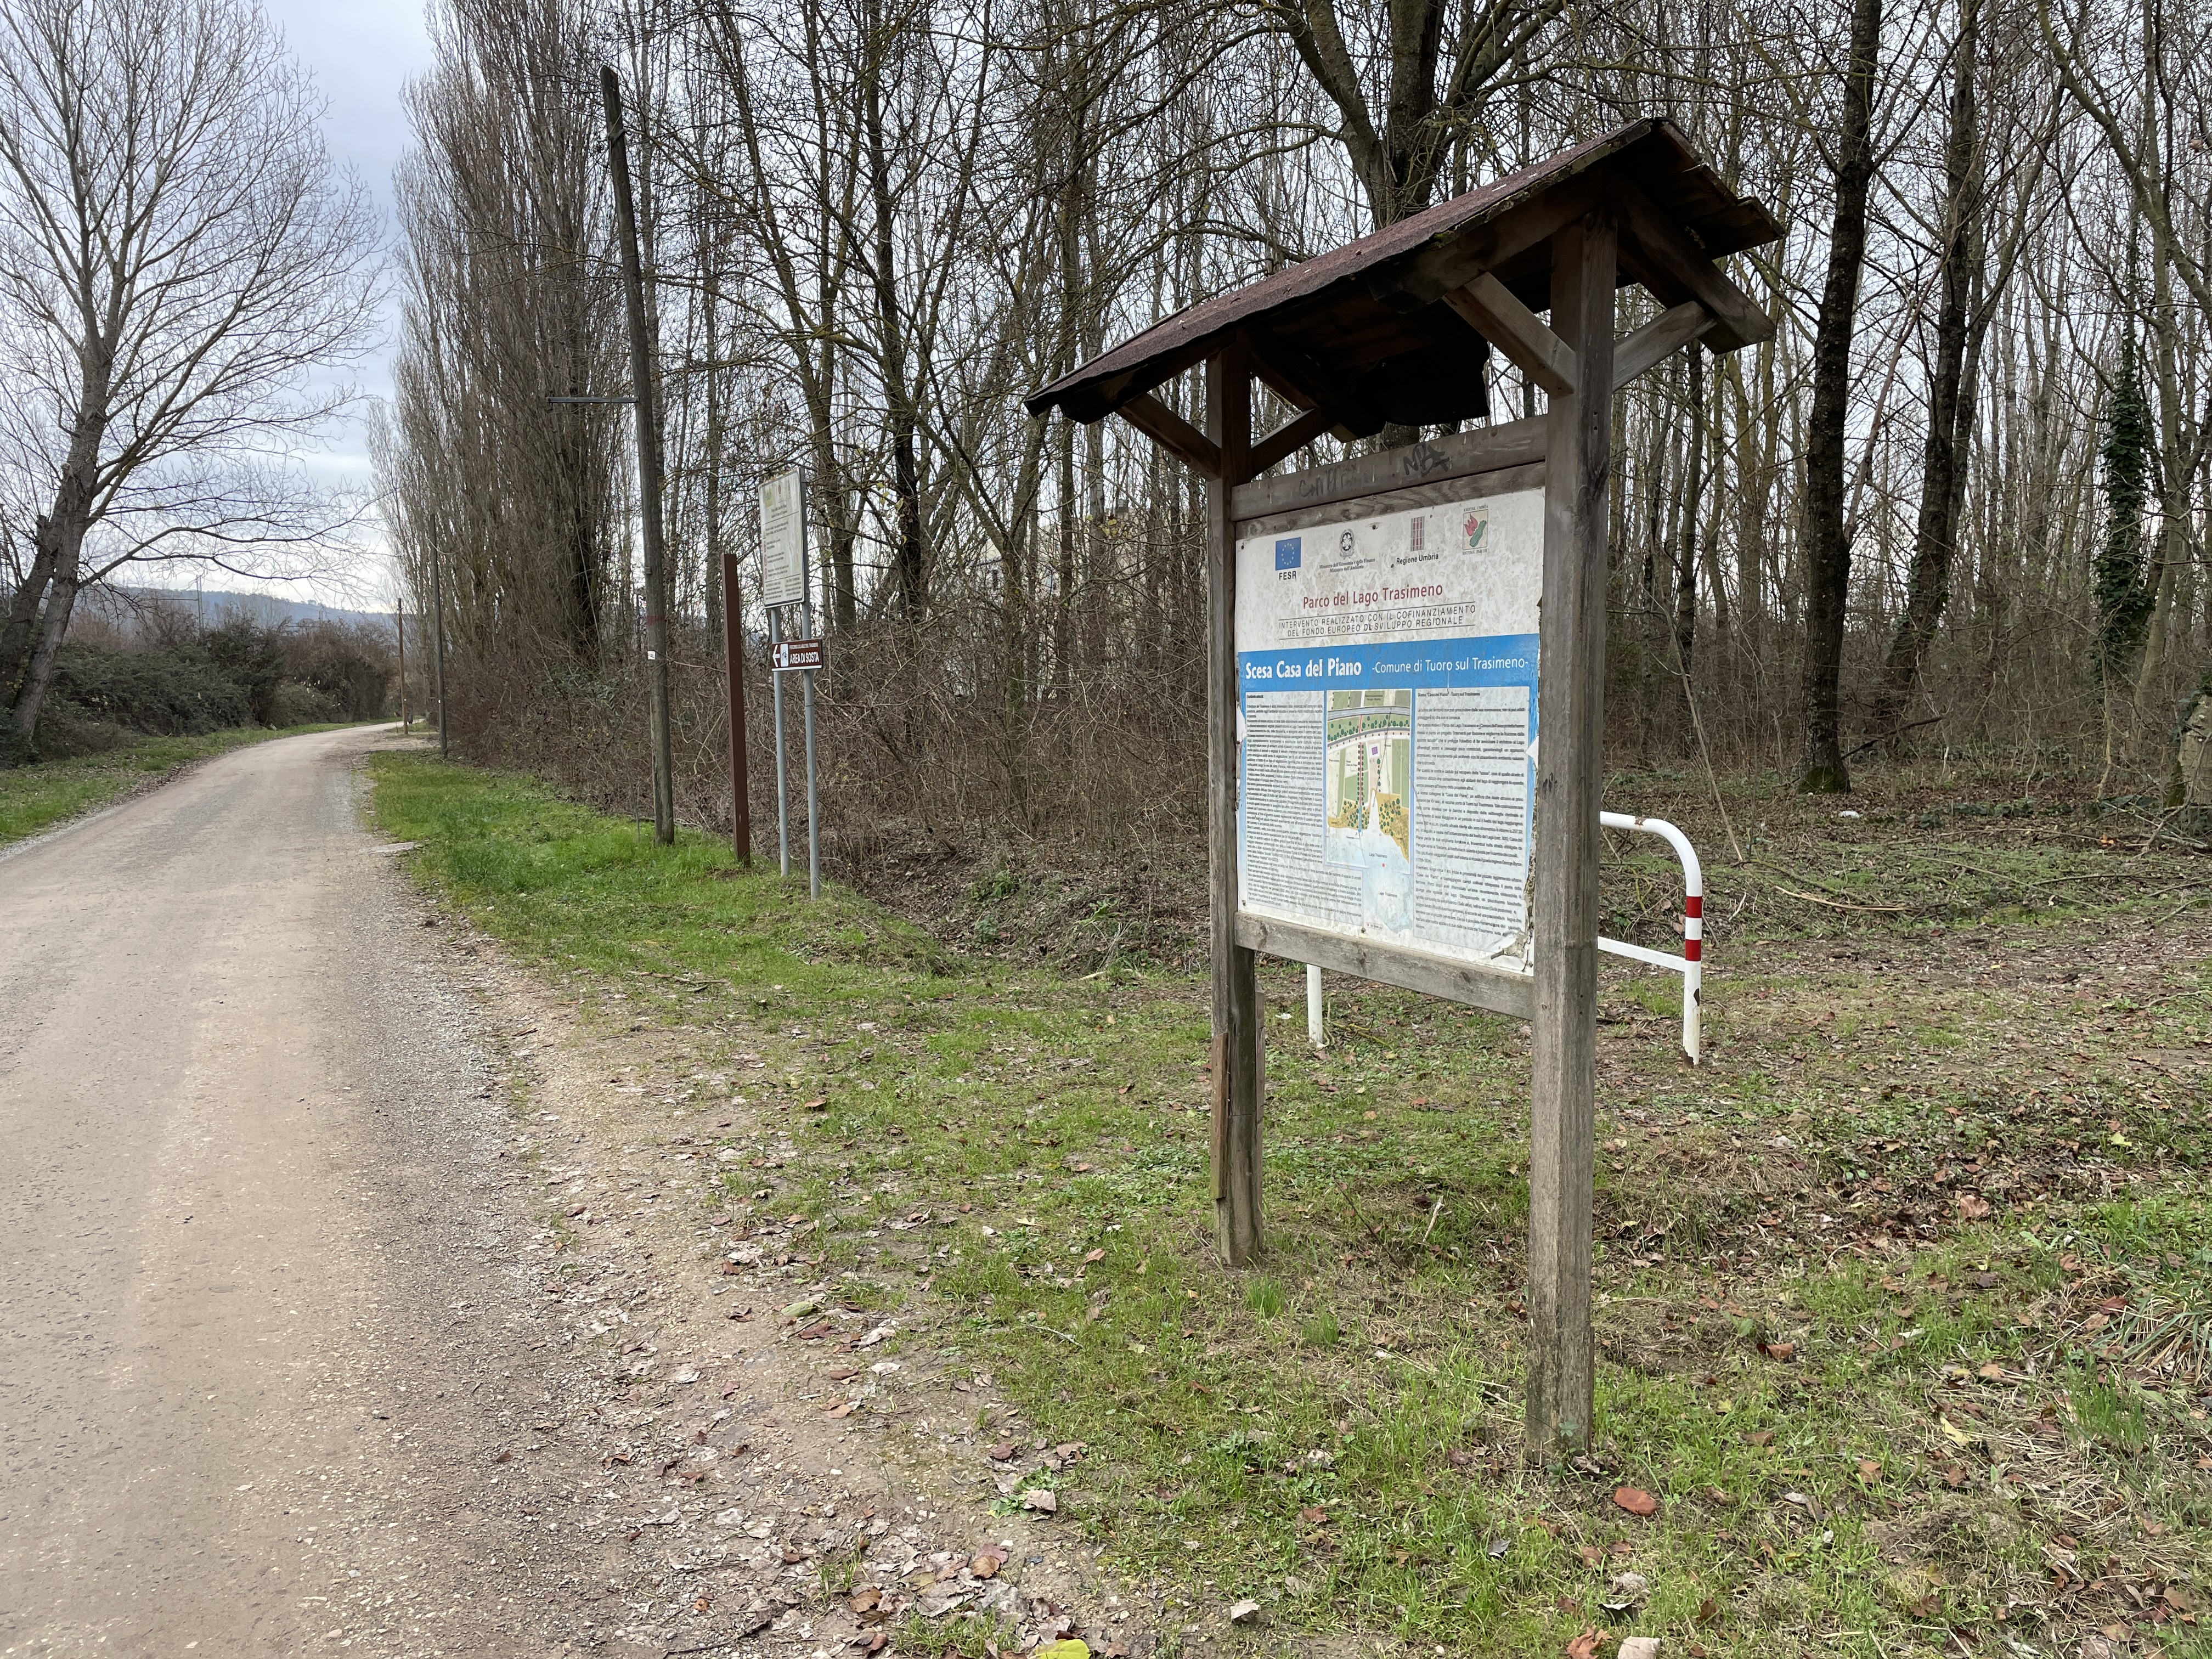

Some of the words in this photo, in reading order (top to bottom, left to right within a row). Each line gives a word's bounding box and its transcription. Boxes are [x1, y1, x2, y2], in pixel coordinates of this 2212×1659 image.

[1396, 556, 1417, 565] Regione
[1419, 553, 1438, 562] Umbria
[1279, 571, 1297, 580] FESR
[1304, 596, 1329, 609] Parco
[1333, 591, 1348, 606] del
[1353, 591, 1378, 606] Lago
[1383, 584, 1443, 601] Trasimeno
[1279, 619, 1318, 629] INTERVENTO
[1322, 614, 1364, 626] REALIZZATO
[1368, 613, 1383, 622] CON
[1387, 611, 1393, 620] IL
[1397, 605, 1476, 620] COFINANZIAMENTO
[1302, 627, 1324, 636] FONDO
[1328, 624, 1361, 634] EUROPEO
[1364, 623, 1372, 631] DI
[1374, 620, 1412, 630] SVILUPPO
[1415, 616, 1463, 628] REGIONALE
[790, 653, 801, 664] AREA
[801, 652, 805, 663] DI
[805, 651, 820, 663] SOSTA
[1246, 662, 1272, 679] Scesa
[1276, 661, 1301, 678] Casa
[1305, 659, 1323, 677] del
[1328, 657, 1362, 676] Piano
[1372, 662, 1410, 673] -Comune
[1414, 659, 1422, 672] di
[1425, 659, 1453, 672] Tuoro
[1455, 657, 1469, 670] sul
[1472, 656, 1528, 670] Trasimeno-
